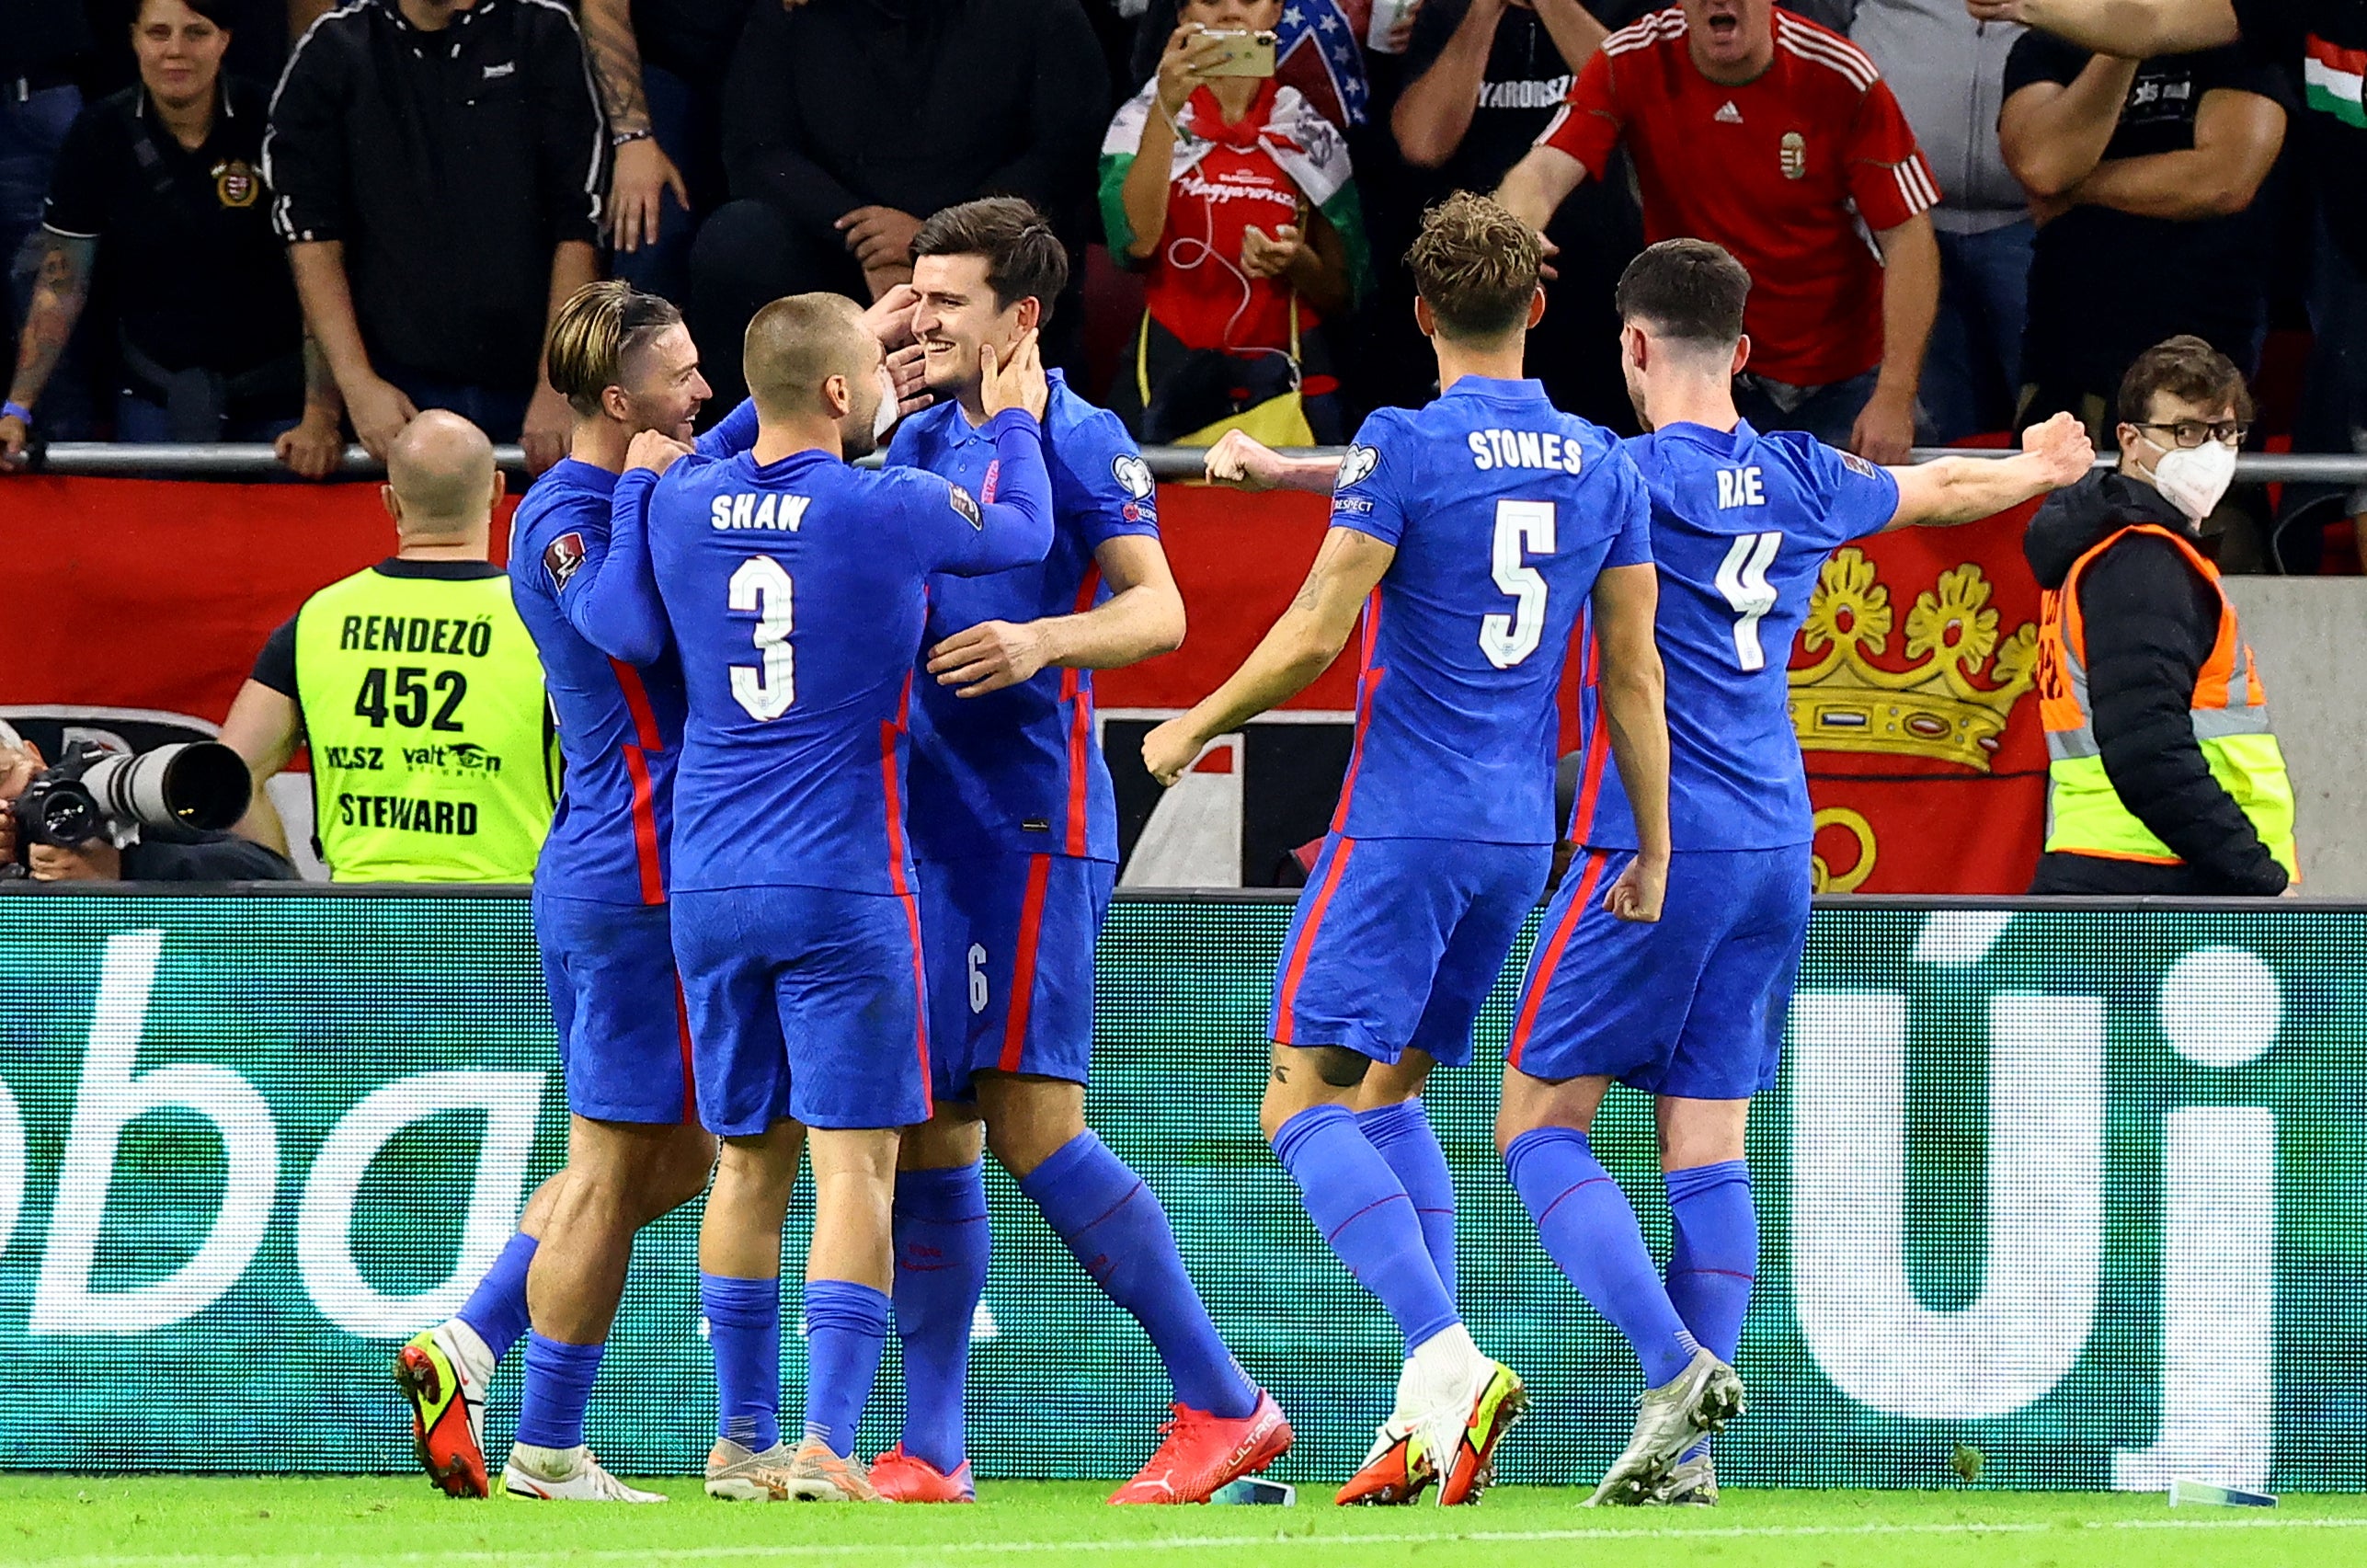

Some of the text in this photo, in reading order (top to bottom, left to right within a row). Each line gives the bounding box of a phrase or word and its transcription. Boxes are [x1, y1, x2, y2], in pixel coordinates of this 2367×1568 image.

[1468, 429, 1583, 475] STONES
[711, 494, 811, 532] SHAW
[1478, 499, 1557, 670] 5
[1714, 531, 1784, 671] 4
[340, 613, 493, 658] RENDEZŐ
[728, 554, 795, 722] 3
[355, 667, 467, 732] 452
[338, 793, 477, 835] STEWARD
[968, 943, 988, 1013] 6
[0, 929, 548, 1339] ba
[1228, 1413, 1277, 1466] ULTRA
